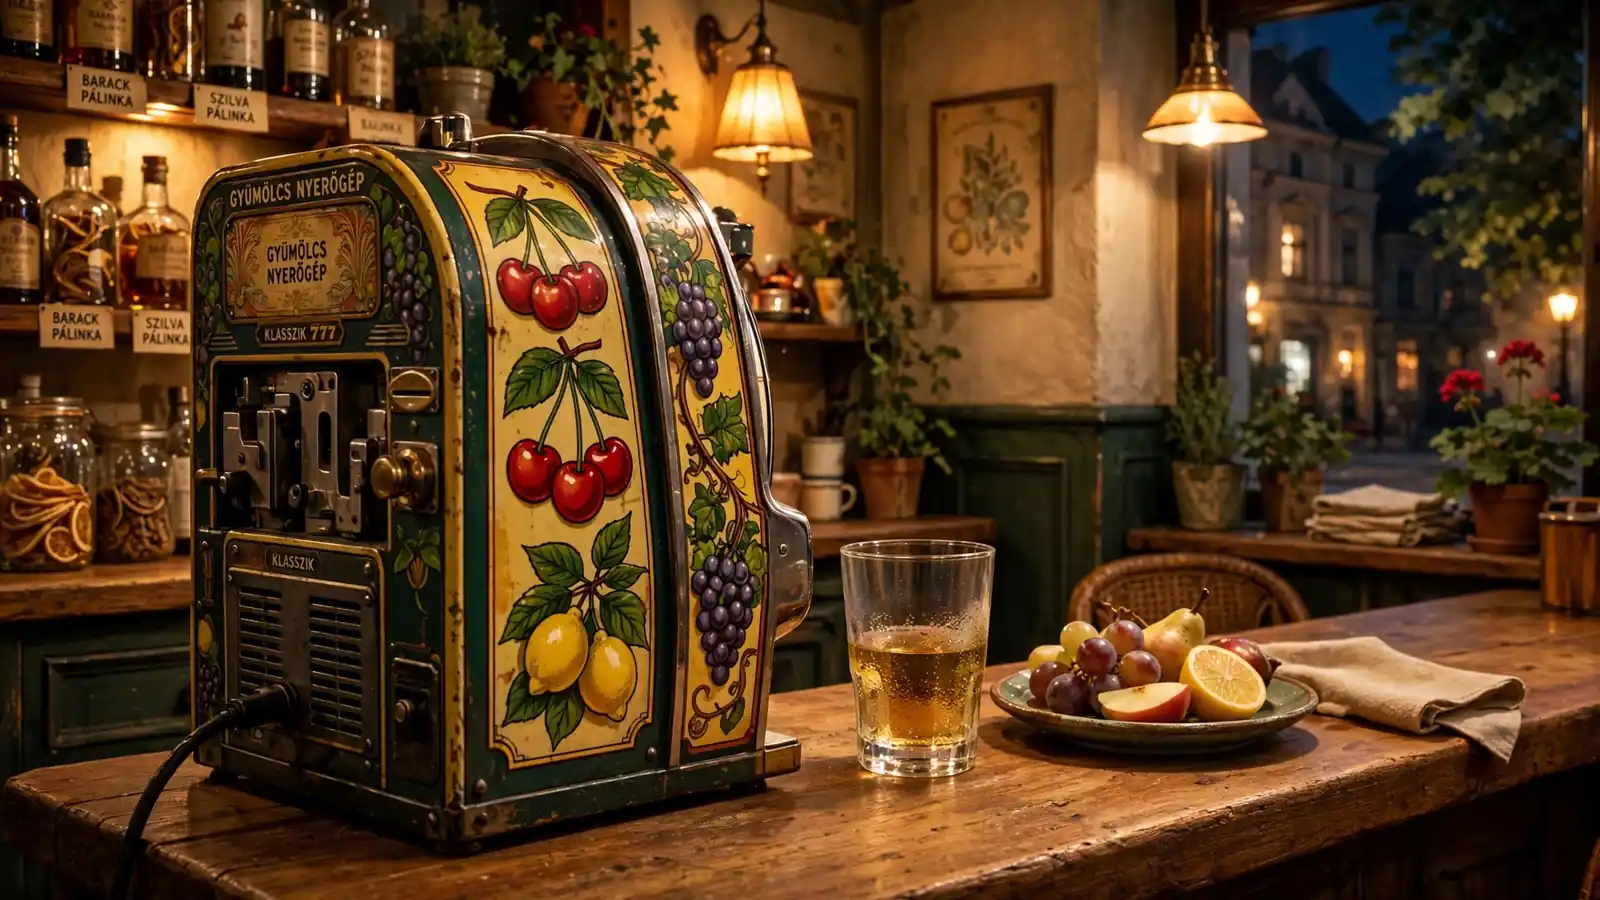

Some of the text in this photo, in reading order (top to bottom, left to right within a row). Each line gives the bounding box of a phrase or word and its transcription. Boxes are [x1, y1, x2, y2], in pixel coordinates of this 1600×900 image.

[82, 74, 131, 91] BARACK
[81, 87, 133, 107] PÁLINKA
[210, 92, 250, 106] SZILVA
[207, 104, 255, 124] PÁLINKA
[52, 311, 99, 325] BARACK
[146, 317, 184, 330] SZILVA
[52, 325, 102, 341] PÁLINKA
[142, 328, 190, 345] PÁLINKA
[264, 324, 336, 341] KLASSZIK 777
[271, 553, 315, 572] KLASSZIK
